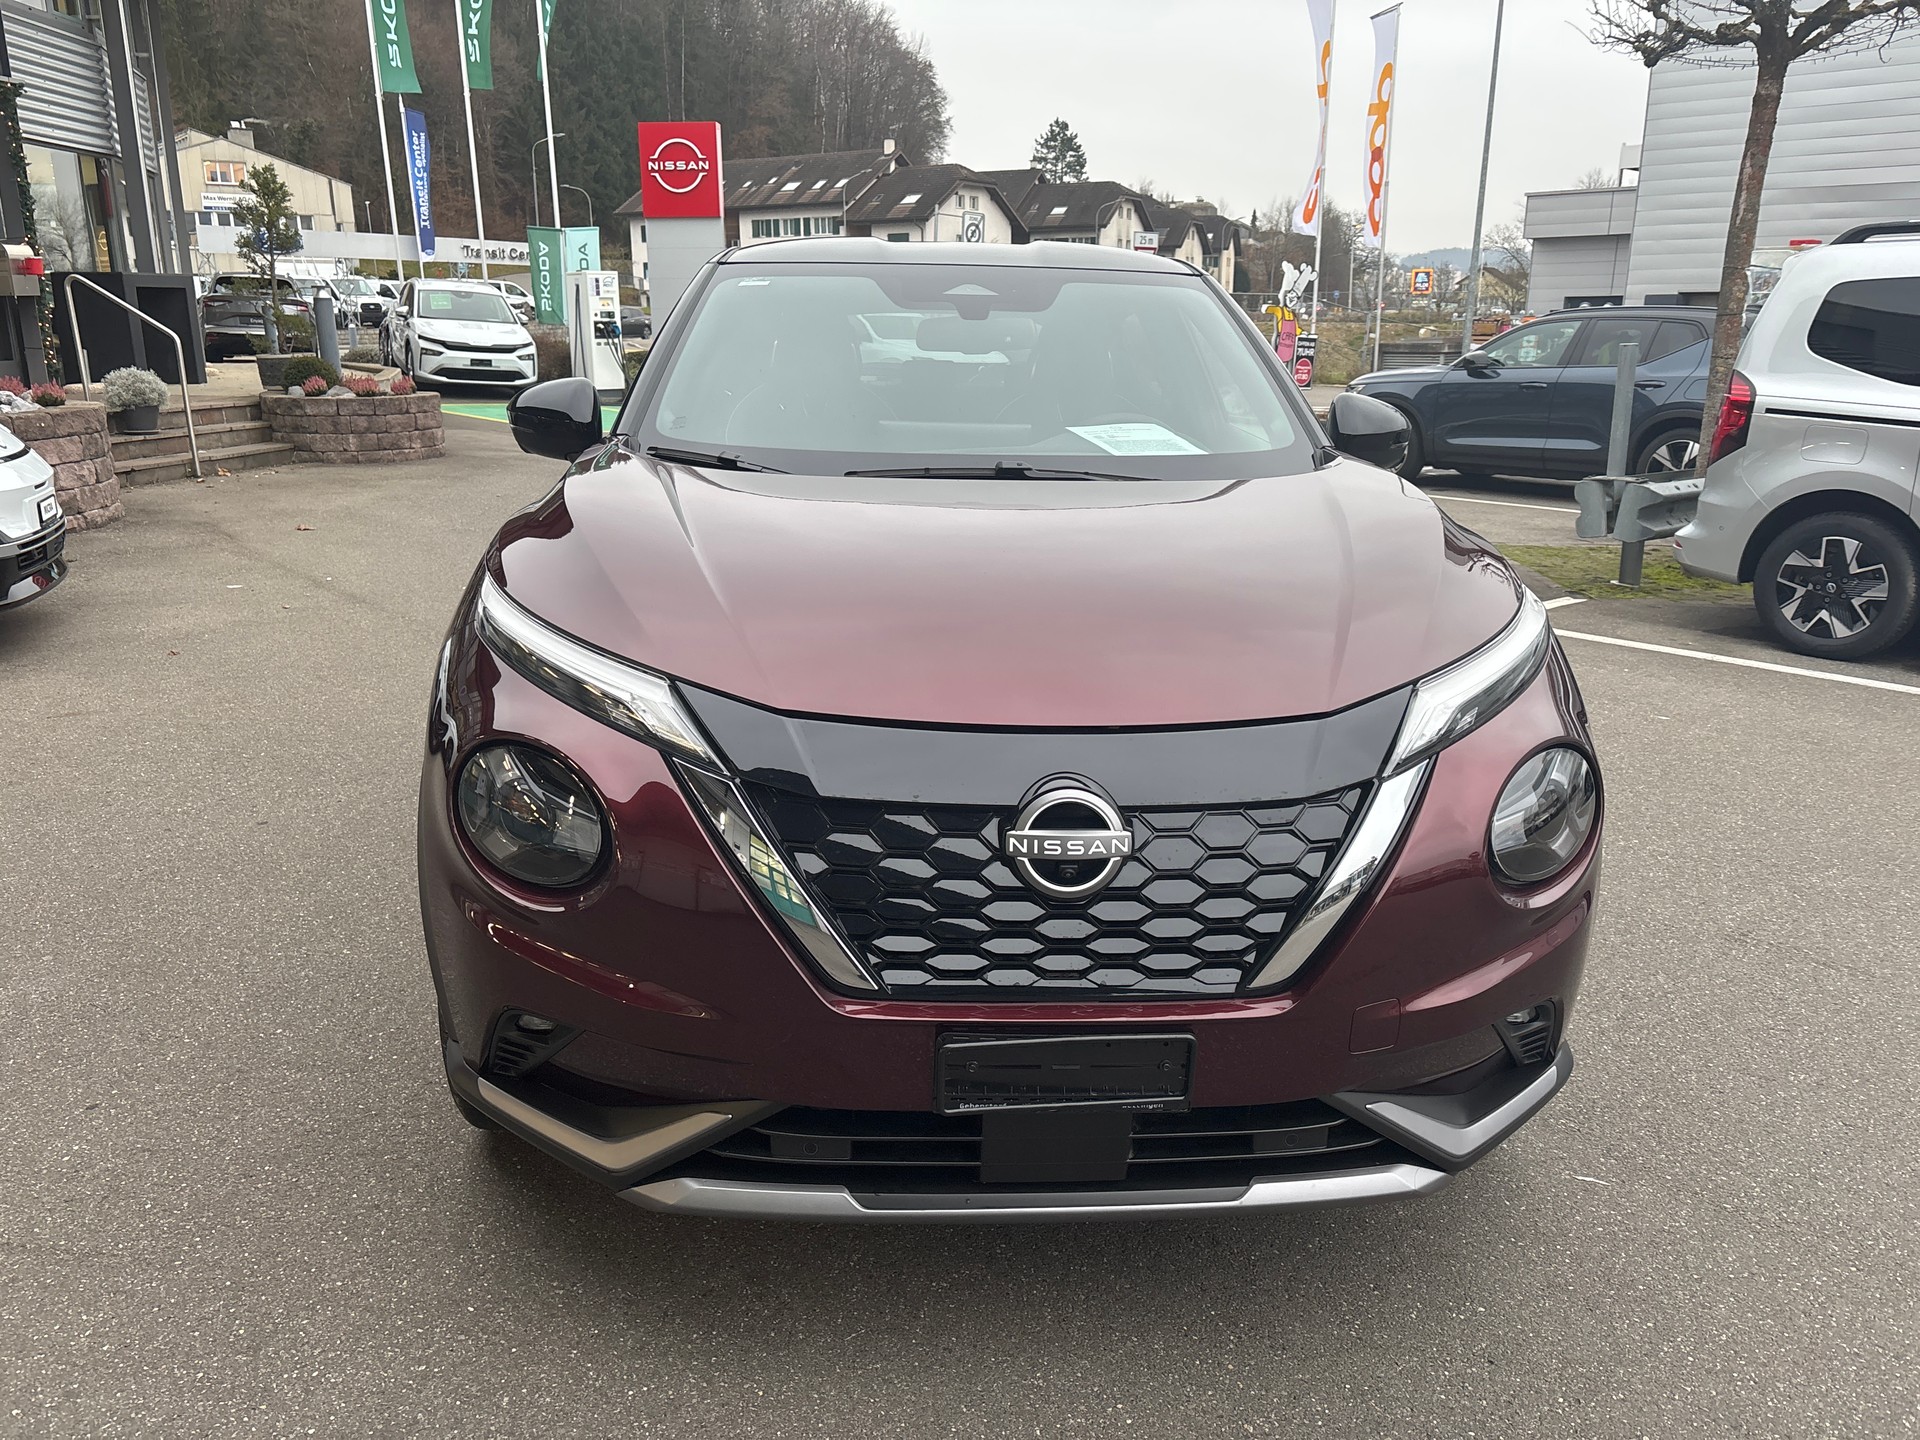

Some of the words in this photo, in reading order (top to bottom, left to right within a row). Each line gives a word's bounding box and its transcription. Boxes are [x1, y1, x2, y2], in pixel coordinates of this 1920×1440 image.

[647, 160, 709, 171] NISSAN
[577, 242, 589, 273] DA
[1008, 837, 1130, 856] NISSAN
